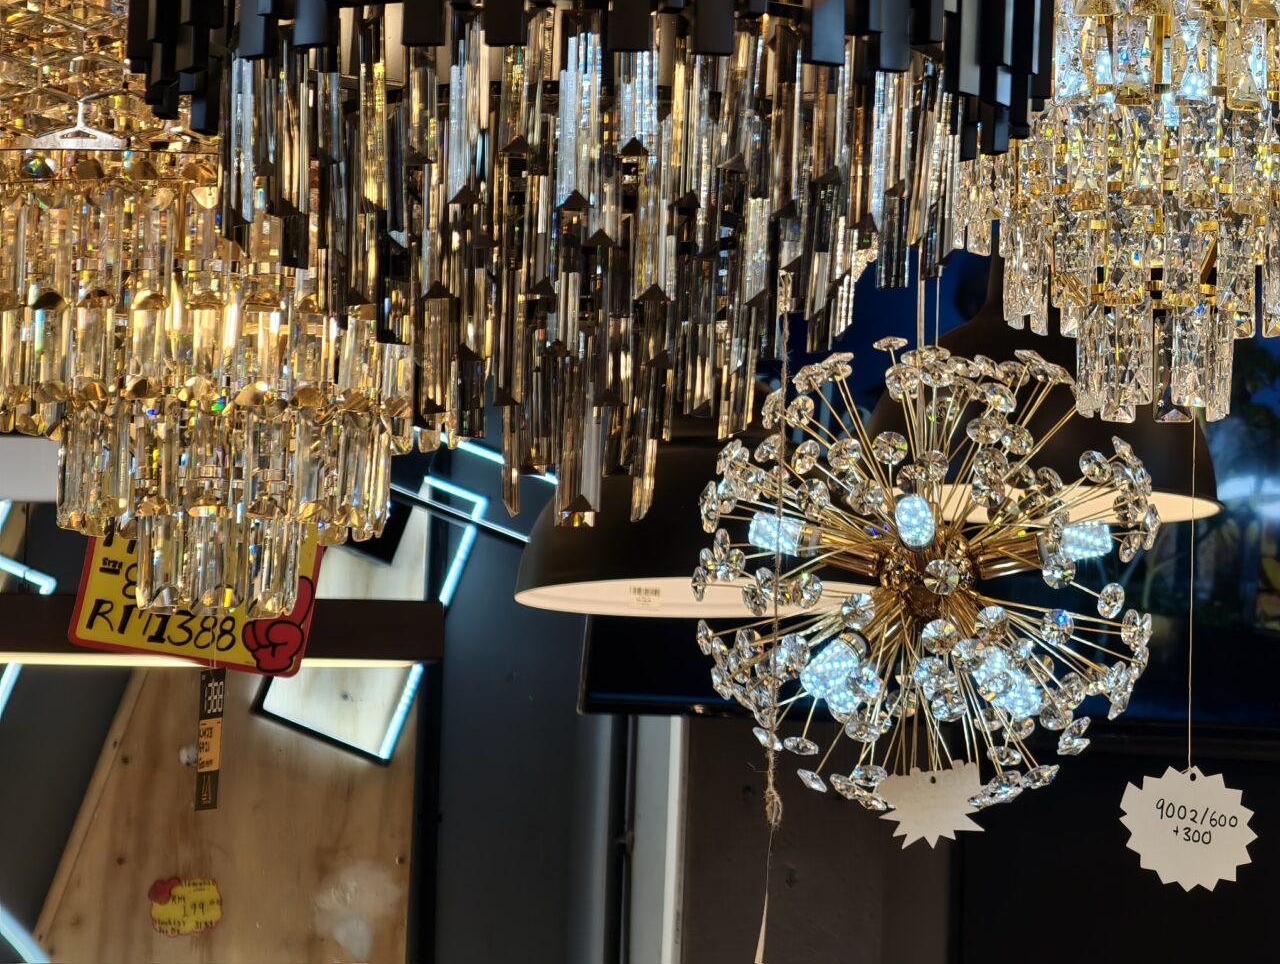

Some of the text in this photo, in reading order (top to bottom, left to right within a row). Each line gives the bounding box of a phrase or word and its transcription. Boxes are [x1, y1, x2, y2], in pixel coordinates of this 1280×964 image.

[86, 598, 236, 652] RM1388
[1155, 798, 1238, 828] 9002/600
[1172, 825, 1212, 845] +300
